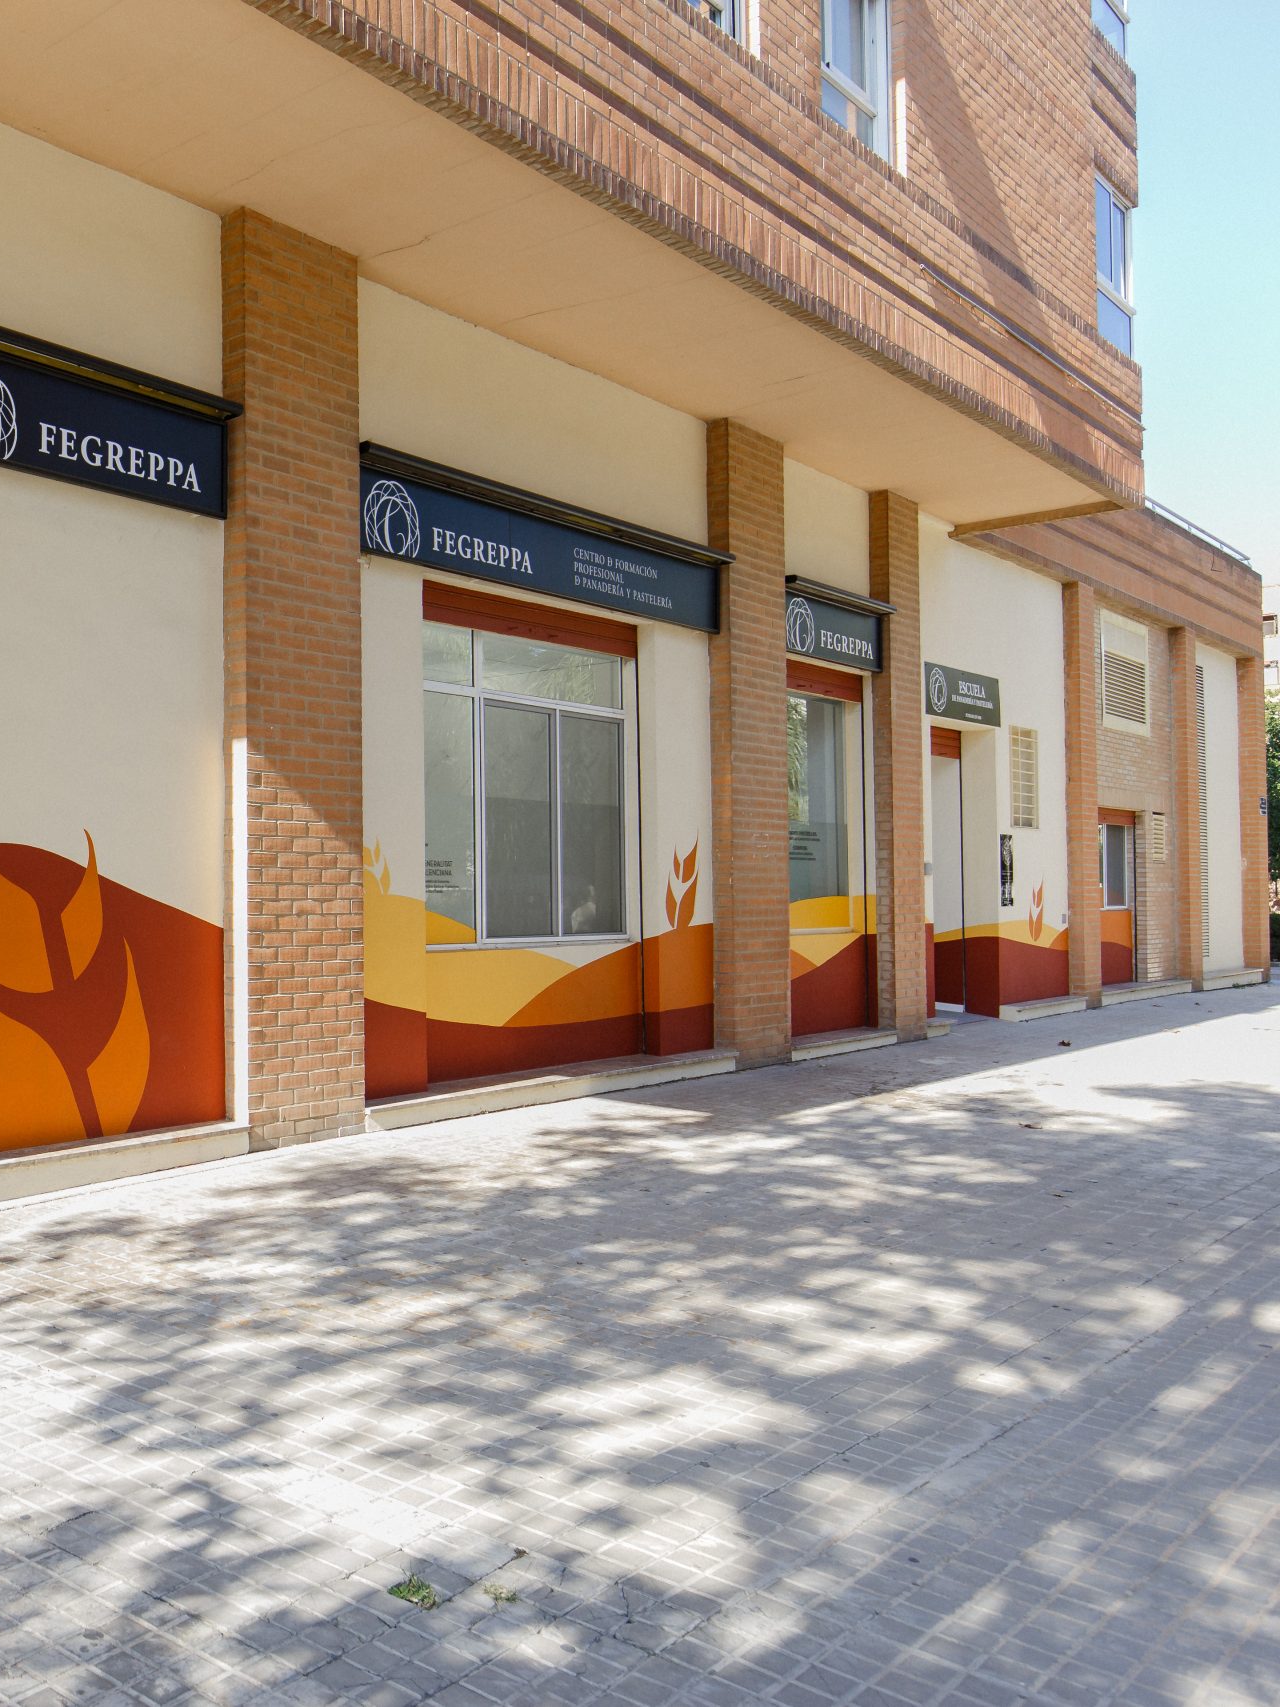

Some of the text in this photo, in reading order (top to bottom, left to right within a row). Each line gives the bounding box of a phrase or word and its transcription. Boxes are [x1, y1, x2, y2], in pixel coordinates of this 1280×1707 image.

[38, 421, 202, 493] FEGREPPA
[432, 527, 533, 574] FEGREPPA
[573, 547, 605, 565] CENTRO
[615, 558, 658, 580] FORMACIÓN
[574, 561, 624, 584] PROFESIONAL
[582, 576, 624, 597] PANADERÍA
[626, 588, 631, 599] Y
[633, 590, 673, 610] PASTELERÍA
[820, 629, 874, 660] FEGREPPA
[958, 680, 986, 699] ESCUELA
